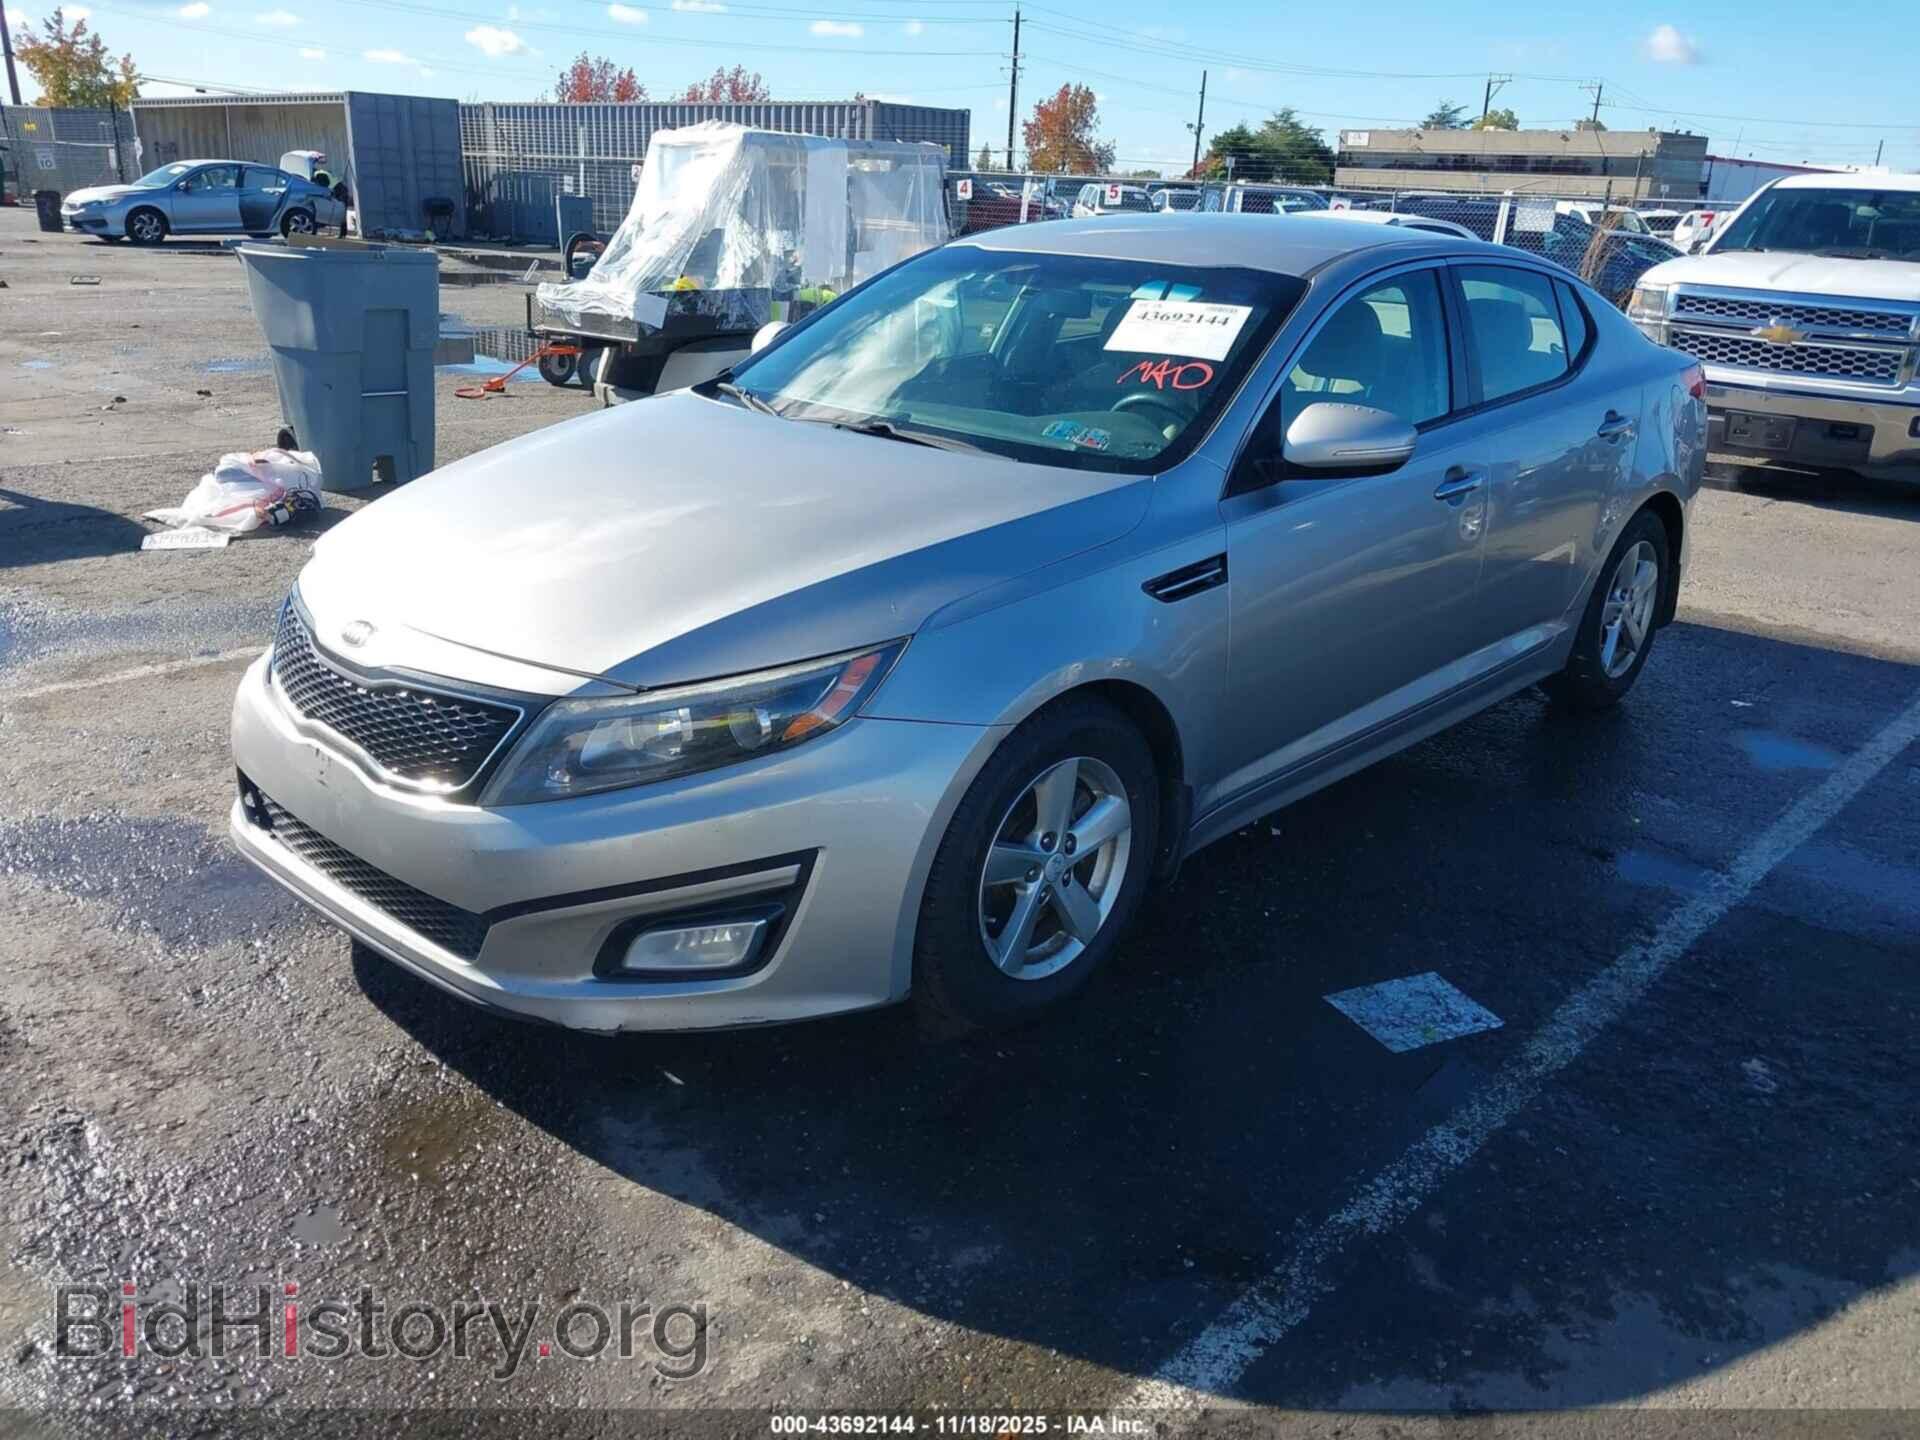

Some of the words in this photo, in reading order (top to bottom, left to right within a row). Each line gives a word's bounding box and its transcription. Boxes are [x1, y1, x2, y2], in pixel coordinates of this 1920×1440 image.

[960, 181, 968, 194] 4
[1110, 184, 1119, 199] 5
[1700, 214, 1714, 228] 7
[1137, 311, 1229, 326] 43692144
